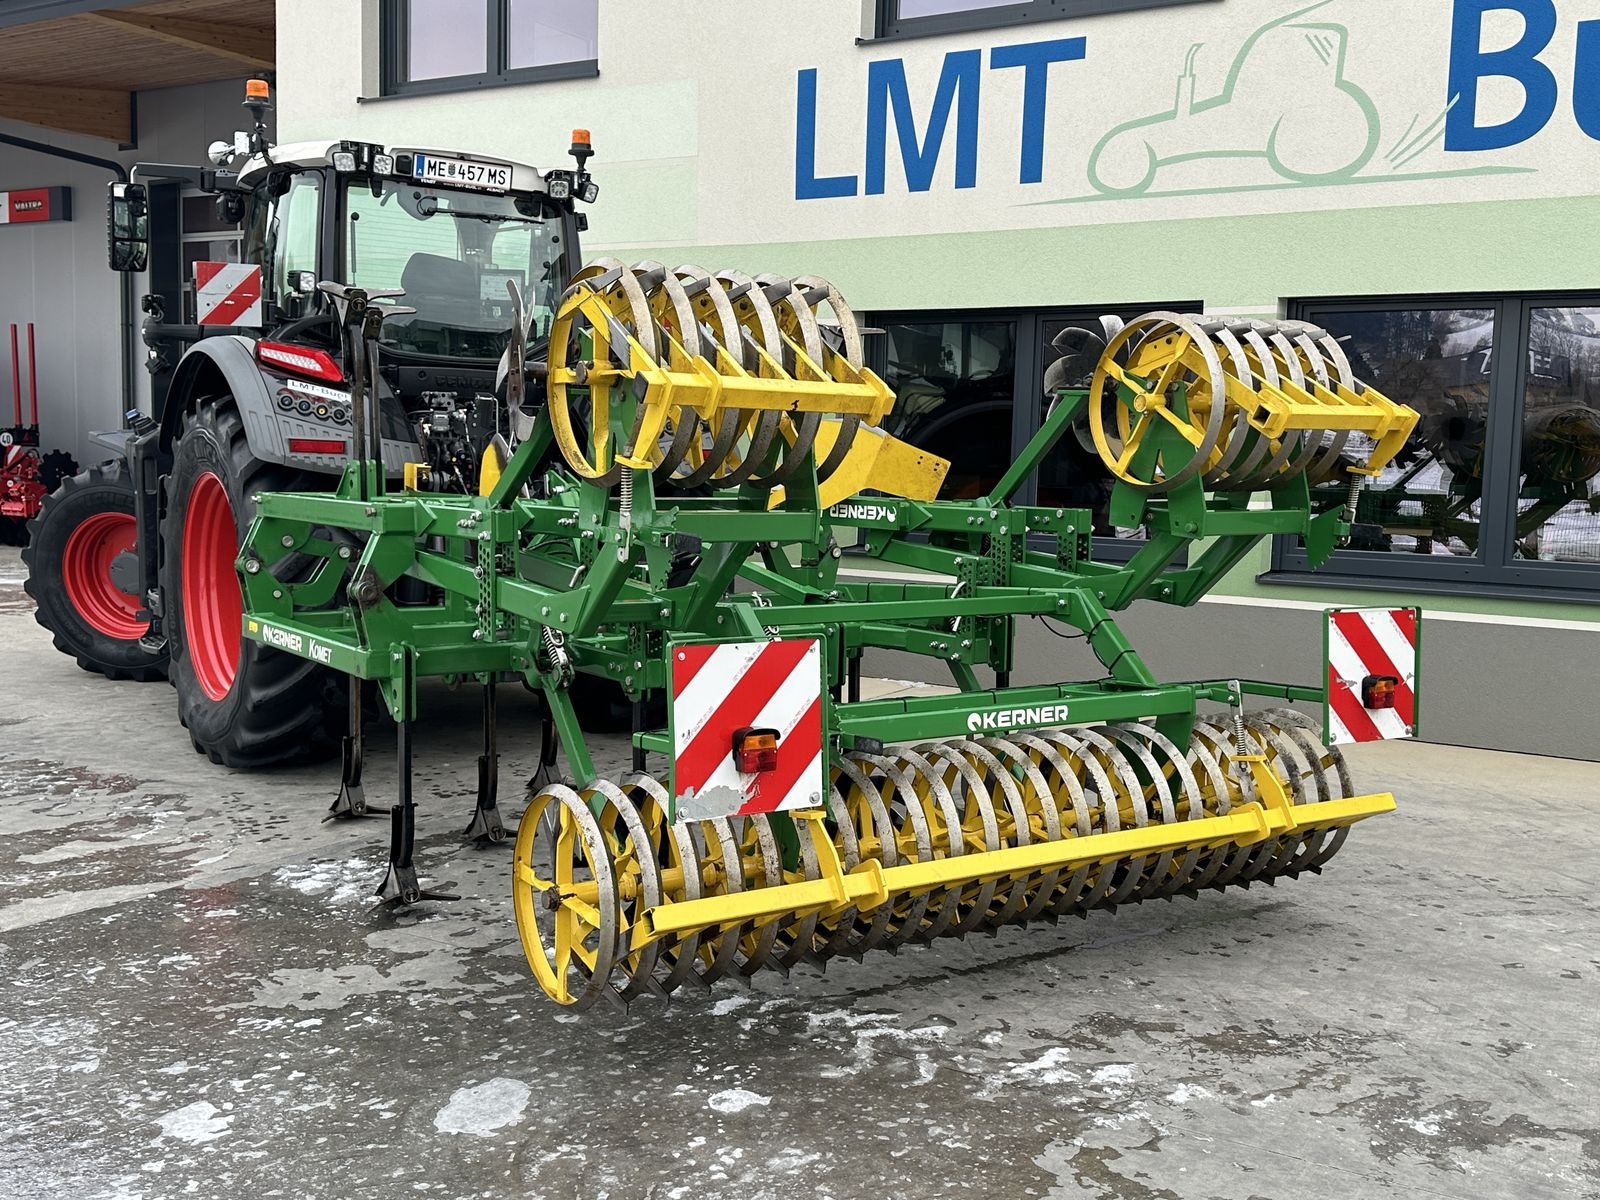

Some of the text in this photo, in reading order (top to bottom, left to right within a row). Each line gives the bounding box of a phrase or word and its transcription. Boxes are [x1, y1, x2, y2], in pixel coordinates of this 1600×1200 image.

[795, 0, 1600, 200] LMT B
[427, 159, 506, 185] ME 457 MS
[267, 627, 303, 653] KERNER
[983, 705, 1069, 729] KERNER
